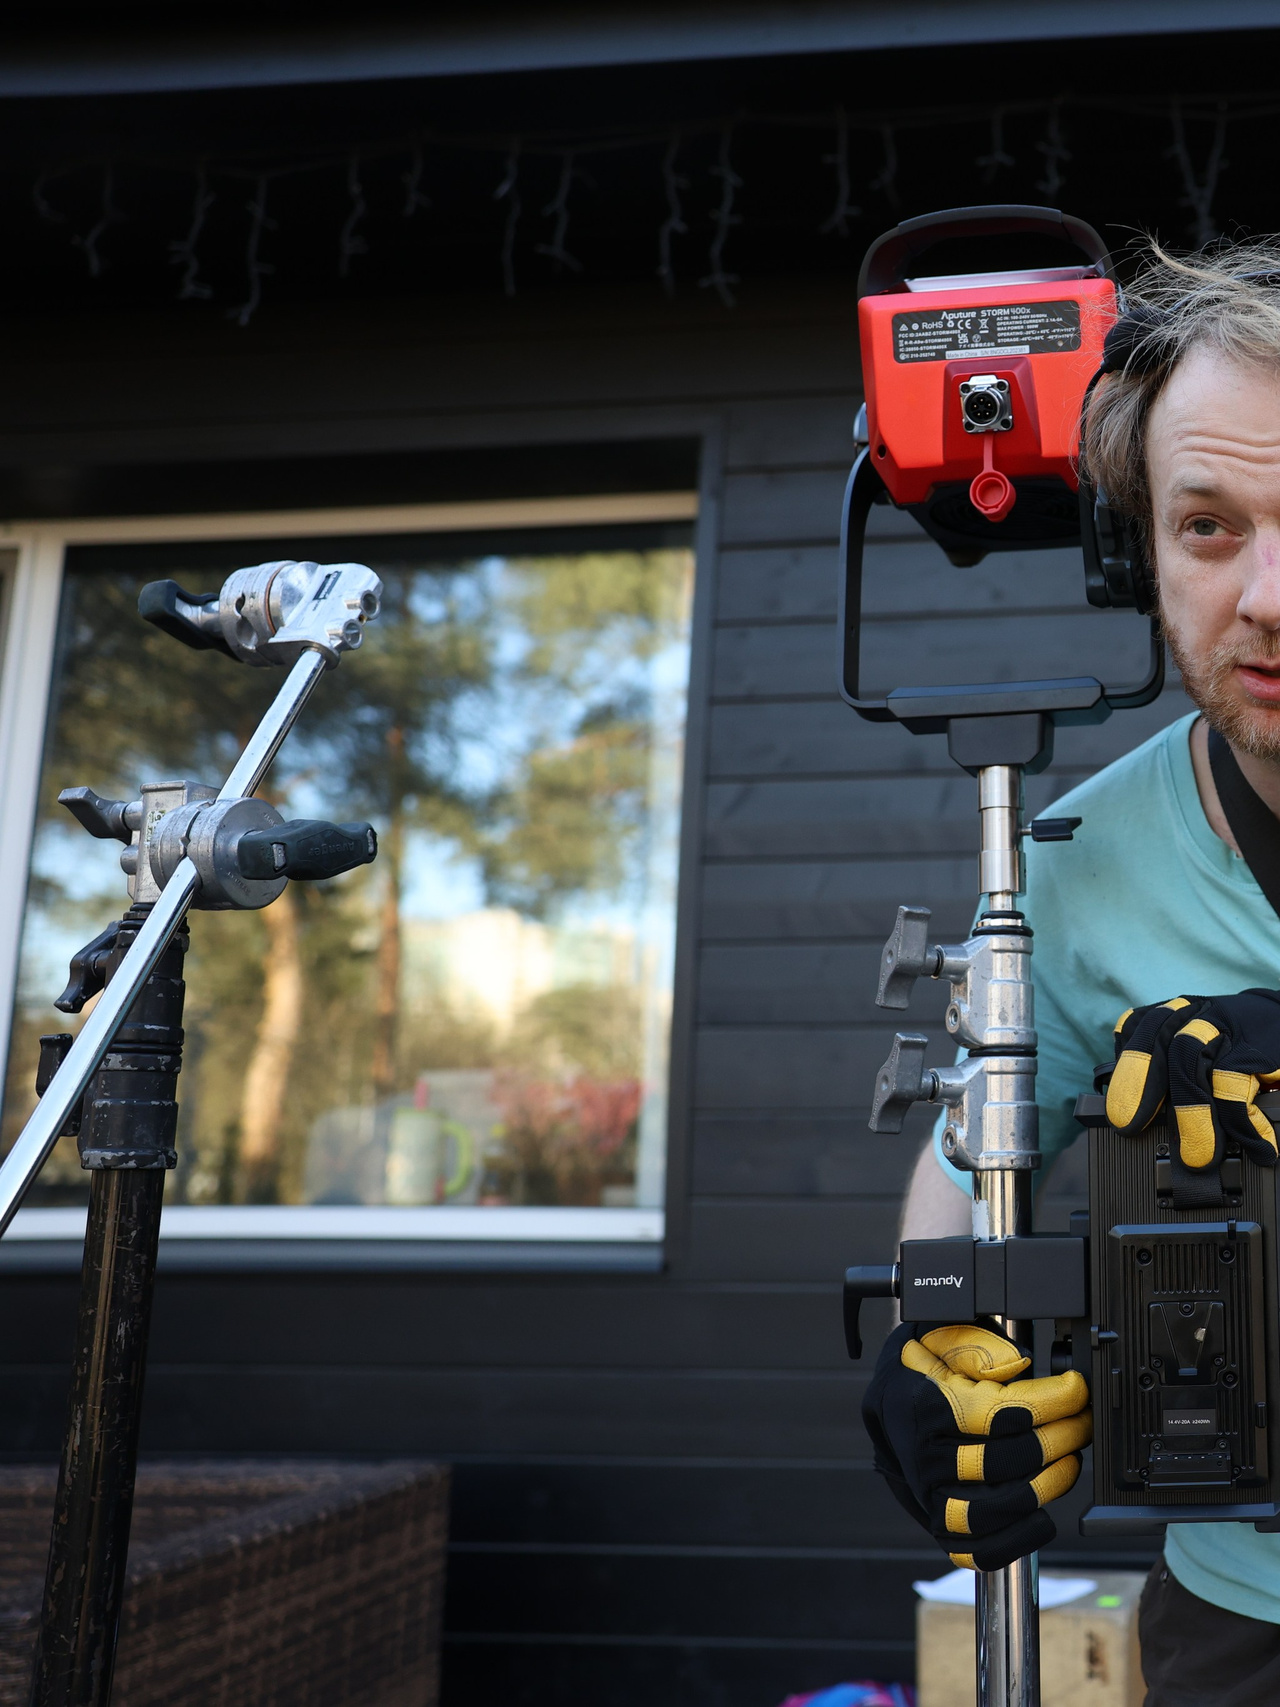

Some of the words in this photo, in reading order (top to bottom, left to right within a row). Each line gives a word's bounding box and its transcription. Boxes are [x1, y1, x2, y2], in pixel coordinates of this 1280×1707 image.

[941, 311, 977, 320] Aputure
[980, 308, 1010, 318] STORM
[1010, 307, 1031, 315] 400x
[921, 321, 943, 330] RoHS
[914, 1275, 964, 1288] Aputure
